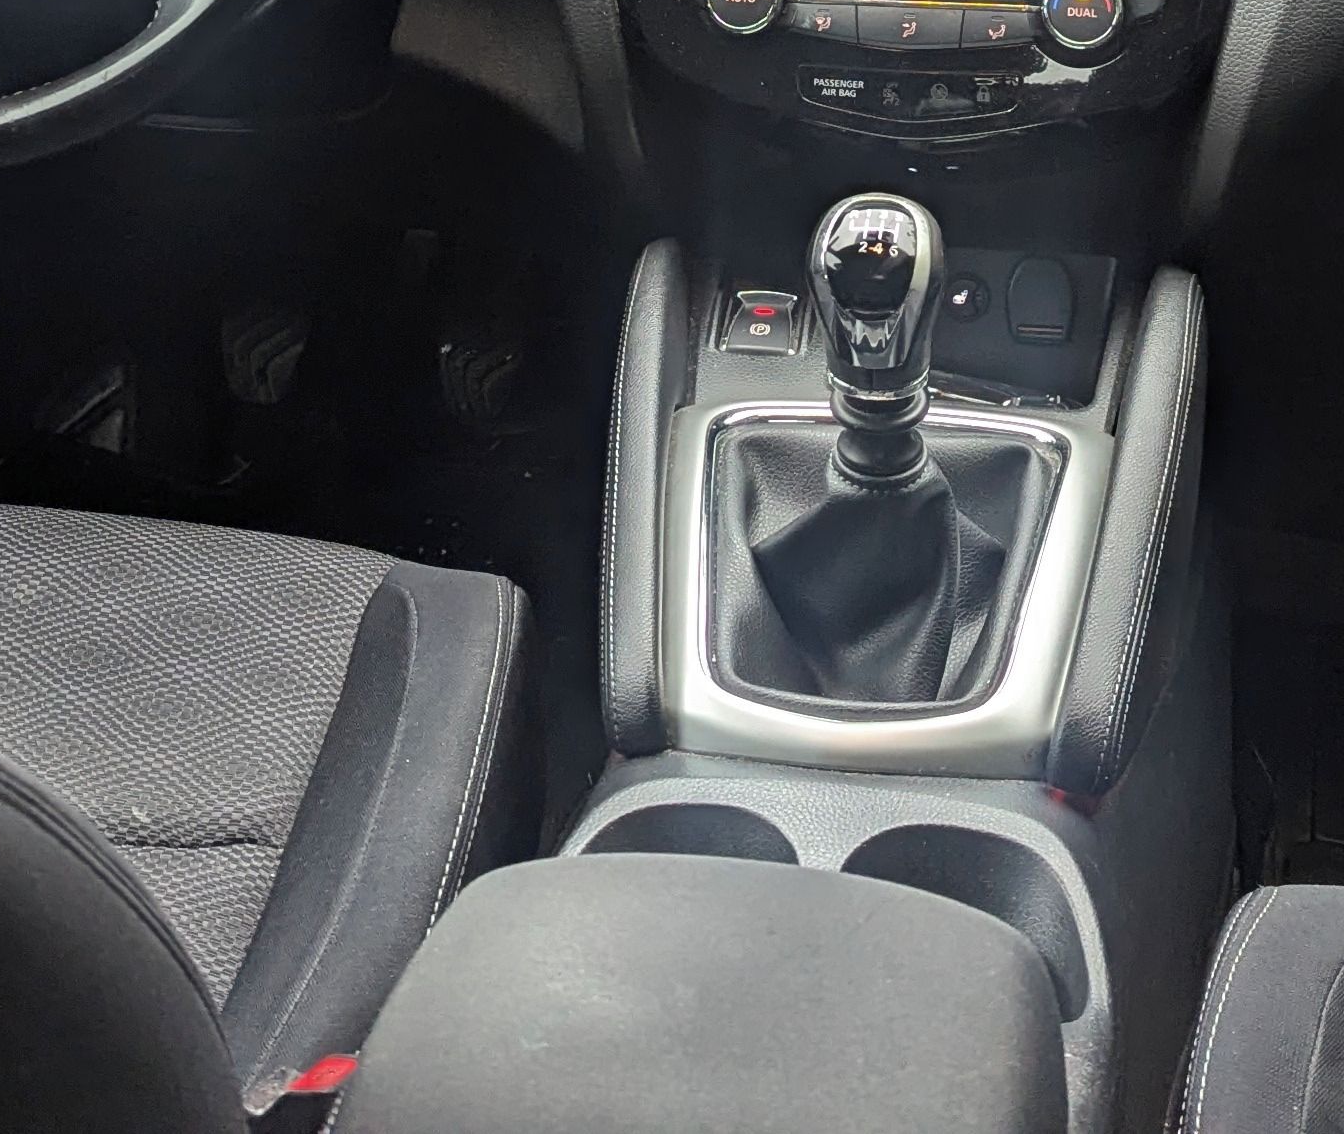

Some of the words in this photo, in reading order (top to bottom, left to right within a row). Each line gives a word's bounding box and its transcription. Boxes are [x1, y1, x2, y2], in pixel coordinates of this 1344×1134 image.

[1067, 7, 1098, 18] DUAL
[813, 78, 864, 89] PASSENGER
[821, 88, 837, 97] AIR
[838, 89, 857, 98] BAG
[858, 241, 868, 253] 2
[875, 242, 884, 255] 4
[889, 245, 899, 258] 6
